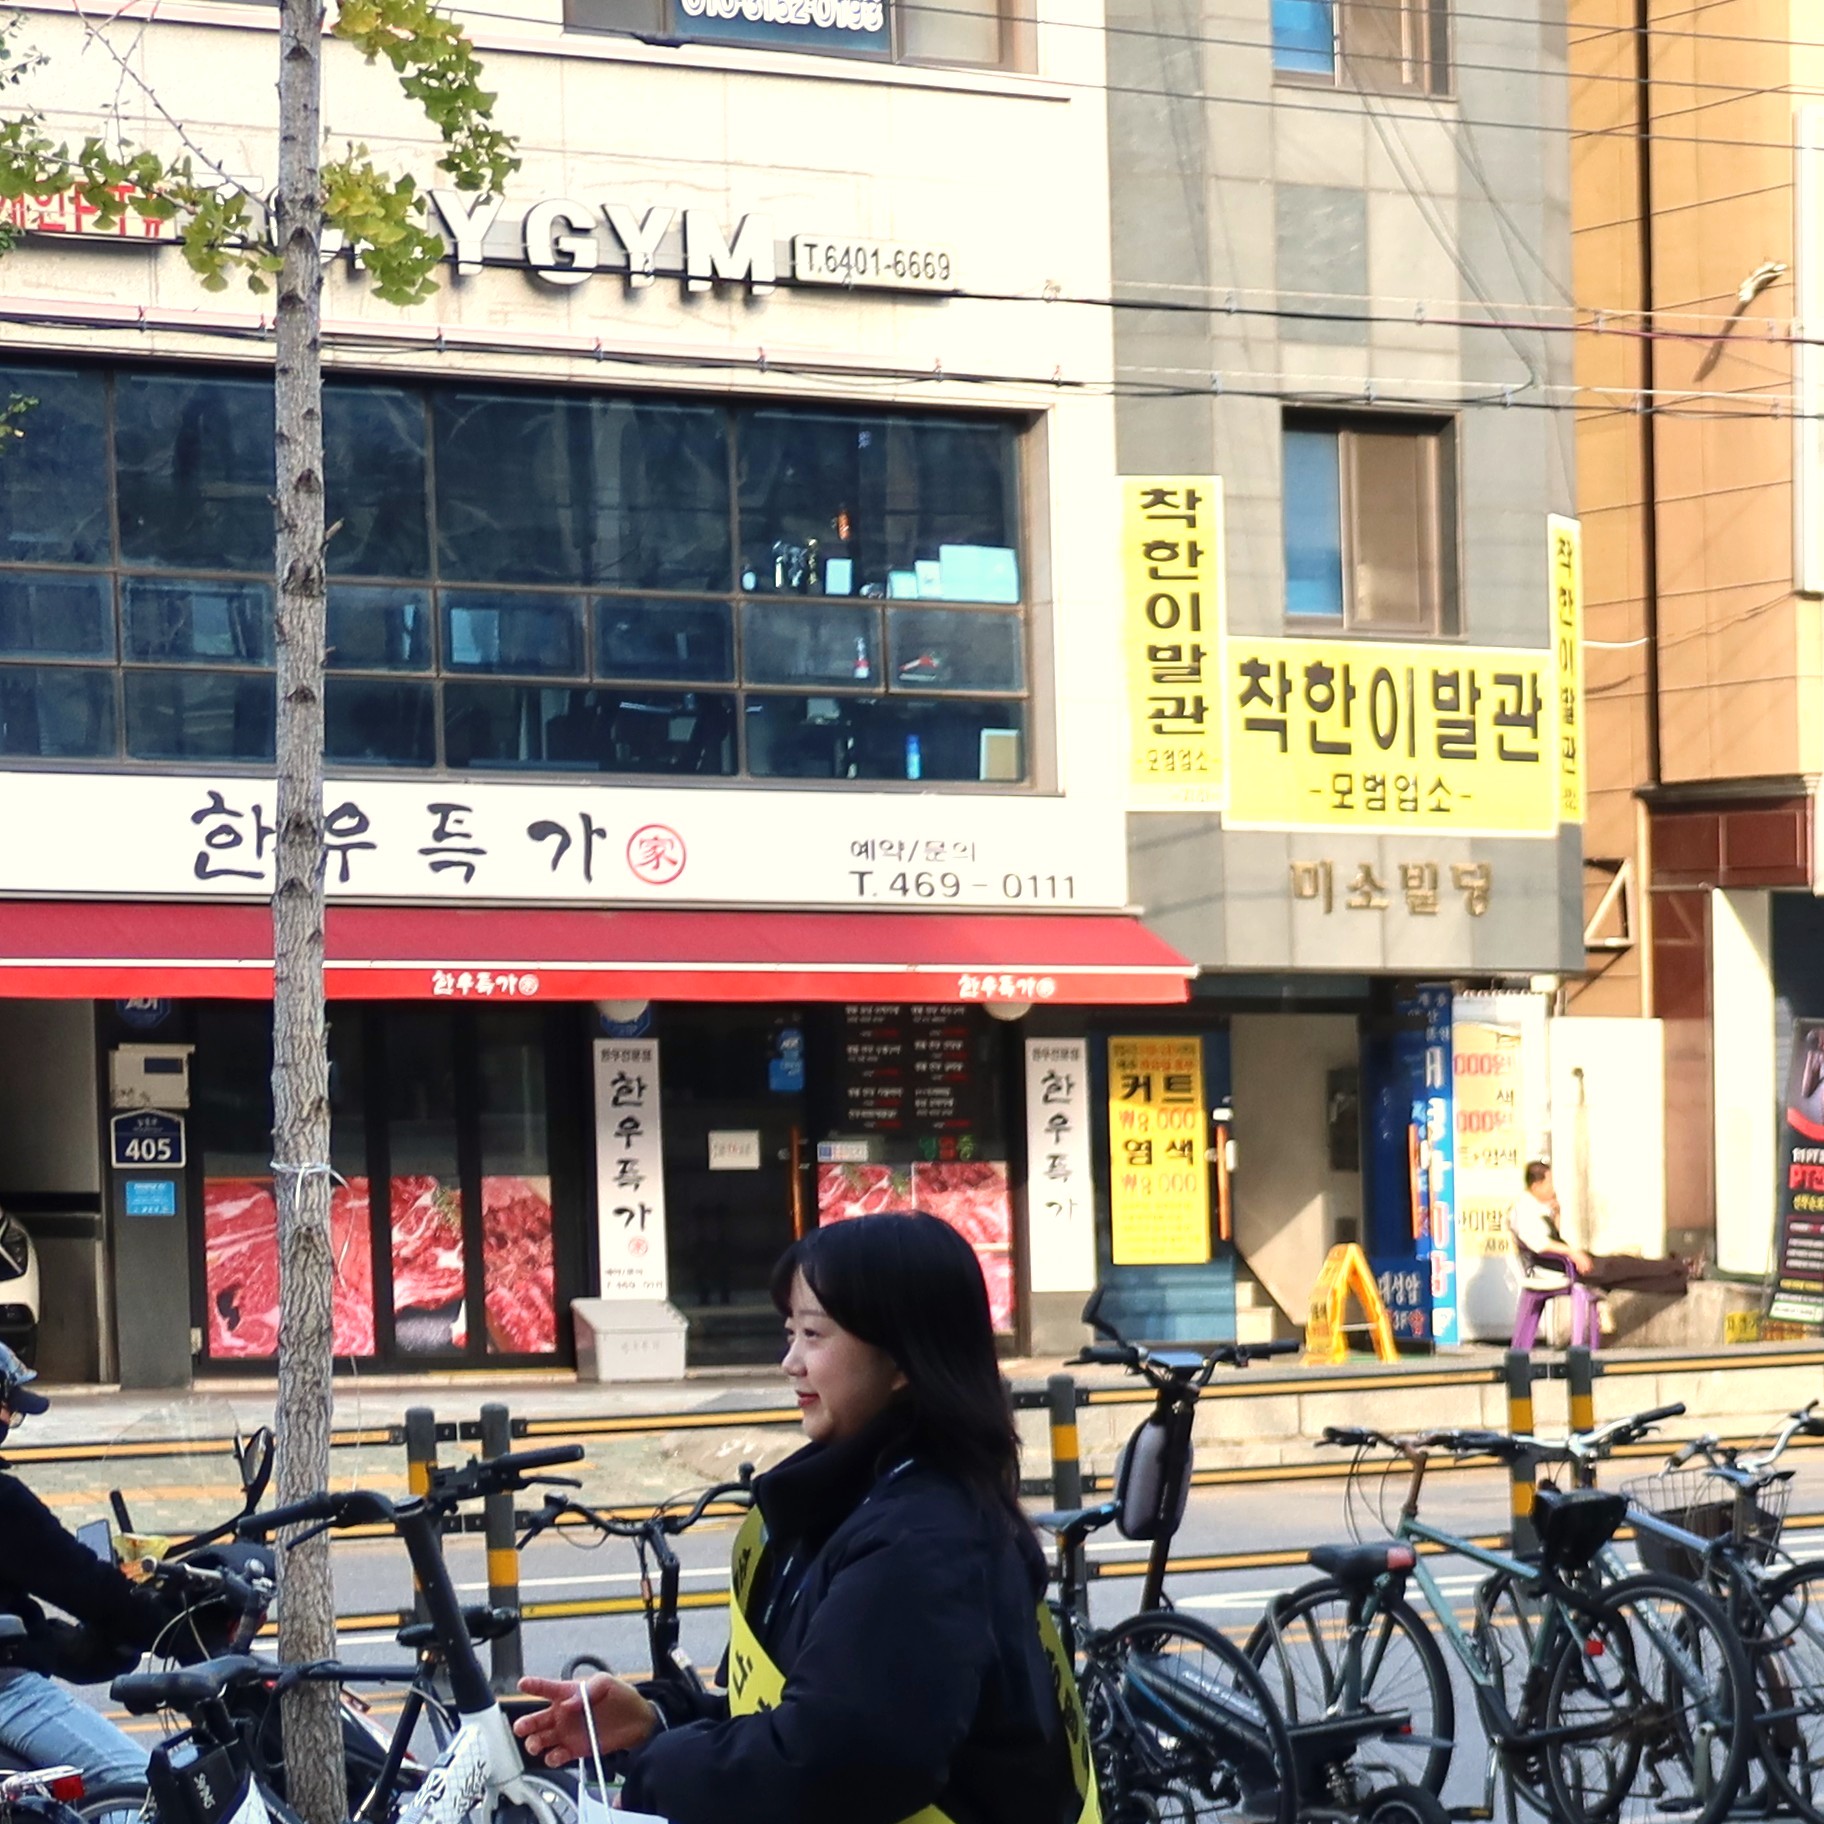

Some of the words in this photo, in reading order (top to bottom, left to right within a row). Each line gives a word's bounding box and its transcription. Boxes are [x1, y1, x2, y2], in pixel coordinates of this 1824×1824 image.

[1139, 488, 1209, 736] 착한이발관
[1238, 656, 1544, 764] 착한이발관
[1290, 858, 1495, 918] 미소빌딩
[125, 1138, 171, 1161] 405
